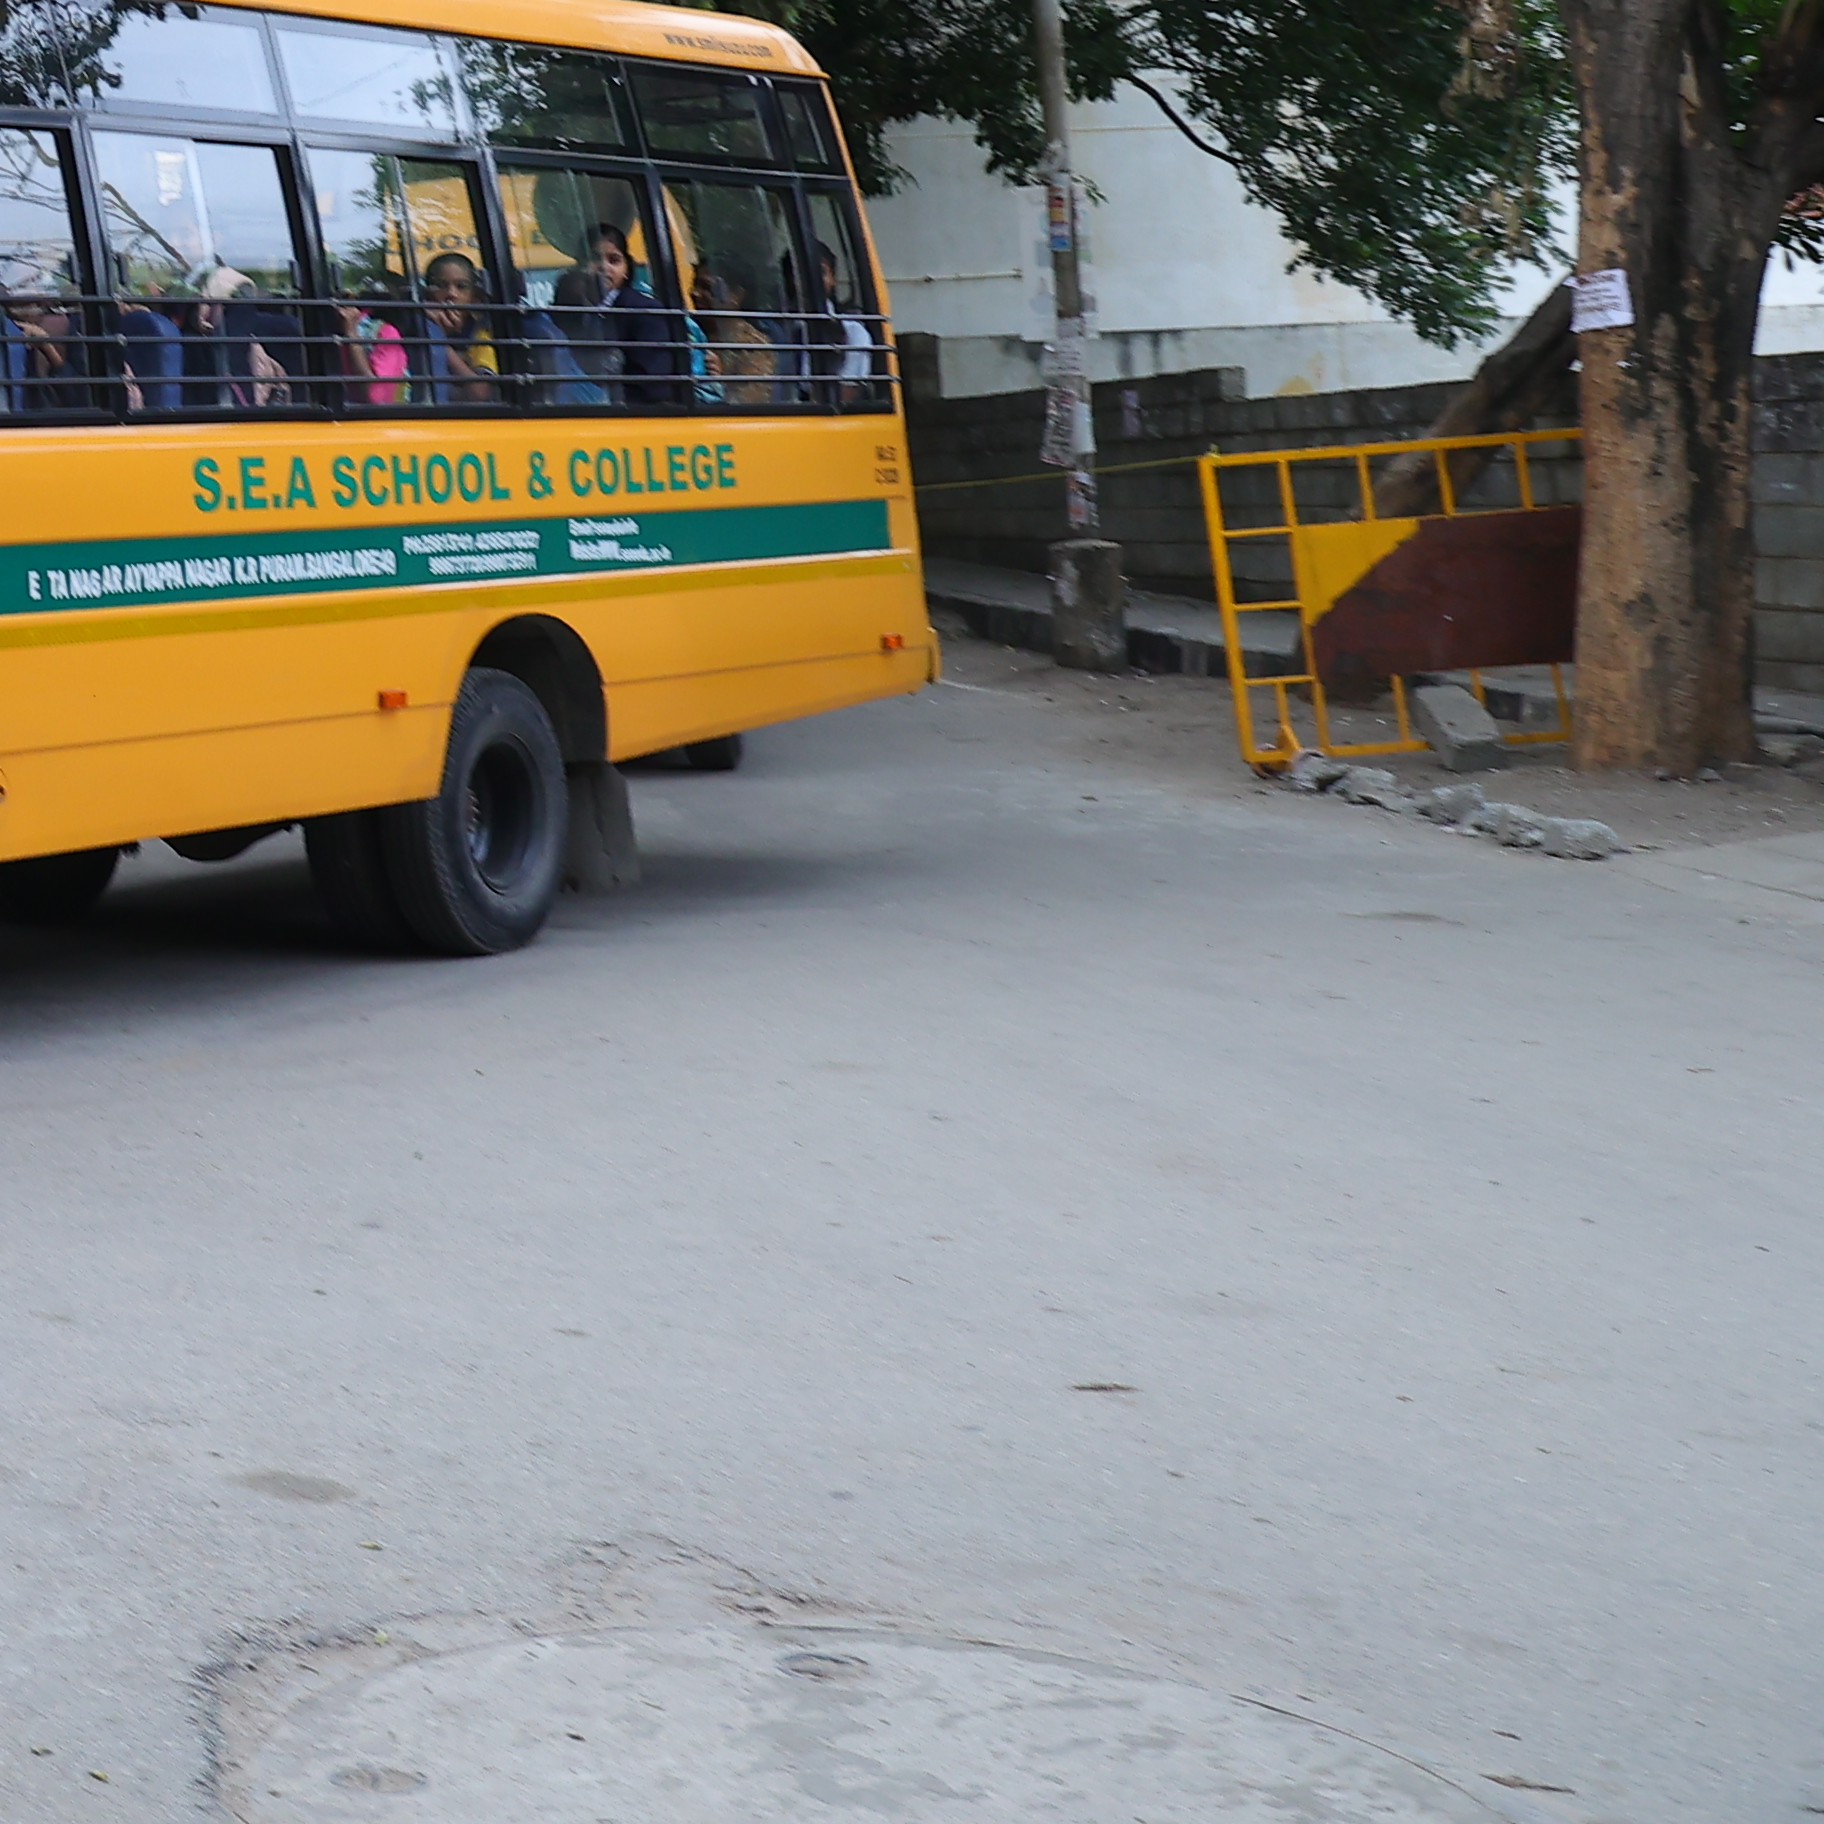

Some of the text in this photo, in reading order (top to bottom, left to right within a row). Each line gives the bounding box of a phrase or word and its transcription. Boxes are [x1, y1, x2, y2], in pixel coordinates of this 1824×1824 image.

[192, 443, 737, 512] S.E.A SCHOOL & COLLEGE
